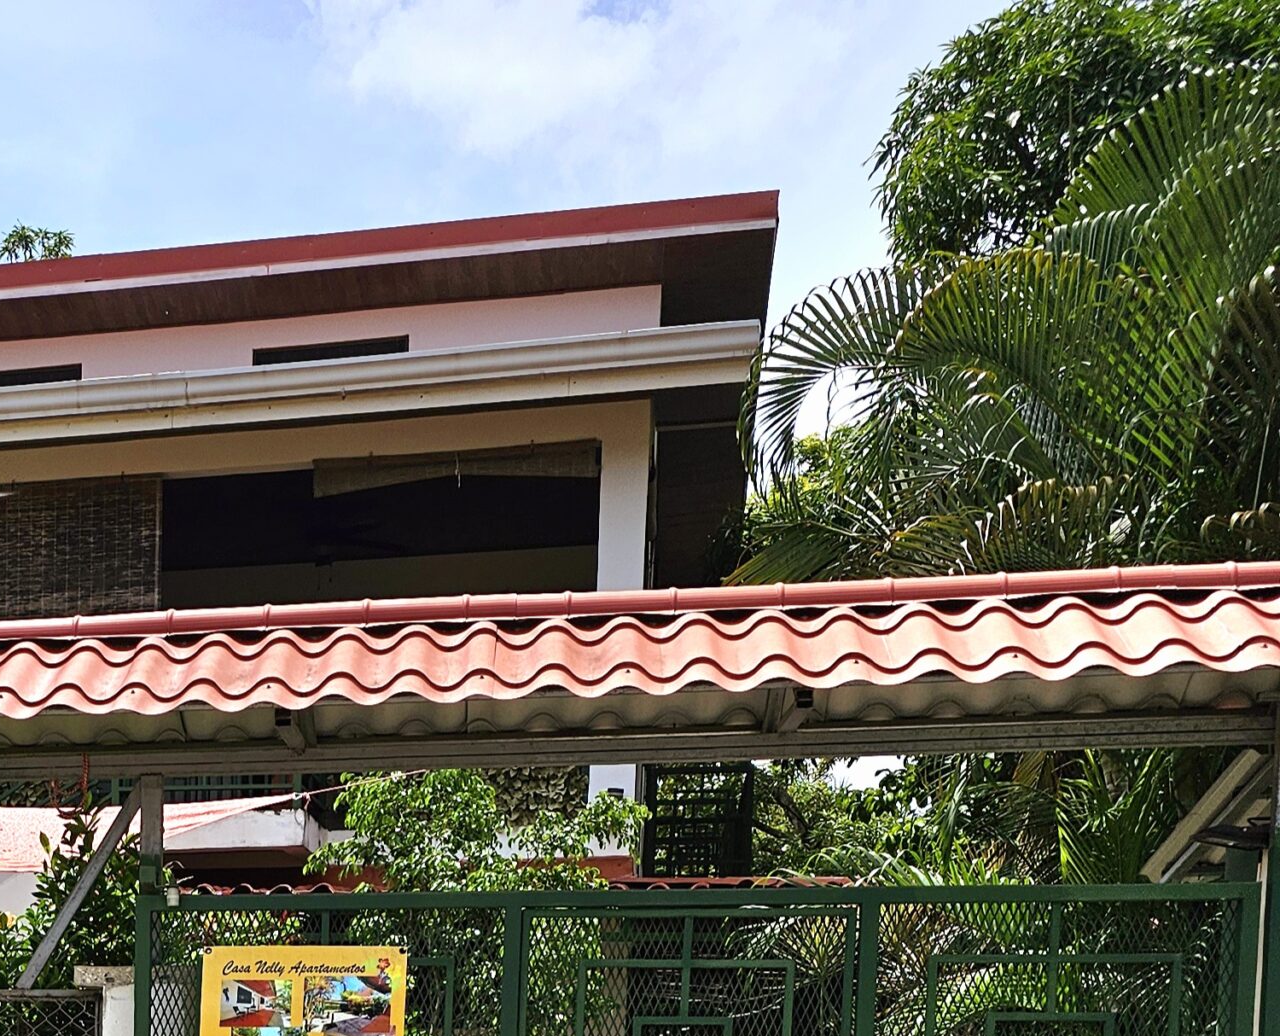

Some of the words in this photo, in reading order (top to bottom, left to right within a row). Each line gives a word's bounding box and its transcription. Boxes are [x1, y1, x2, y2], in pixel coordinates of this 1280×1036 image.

[222, 960, 251, 975] Casa
[255, 960, 286, 977] Nelly
[288, 960, 366, 976] Apartamentos
